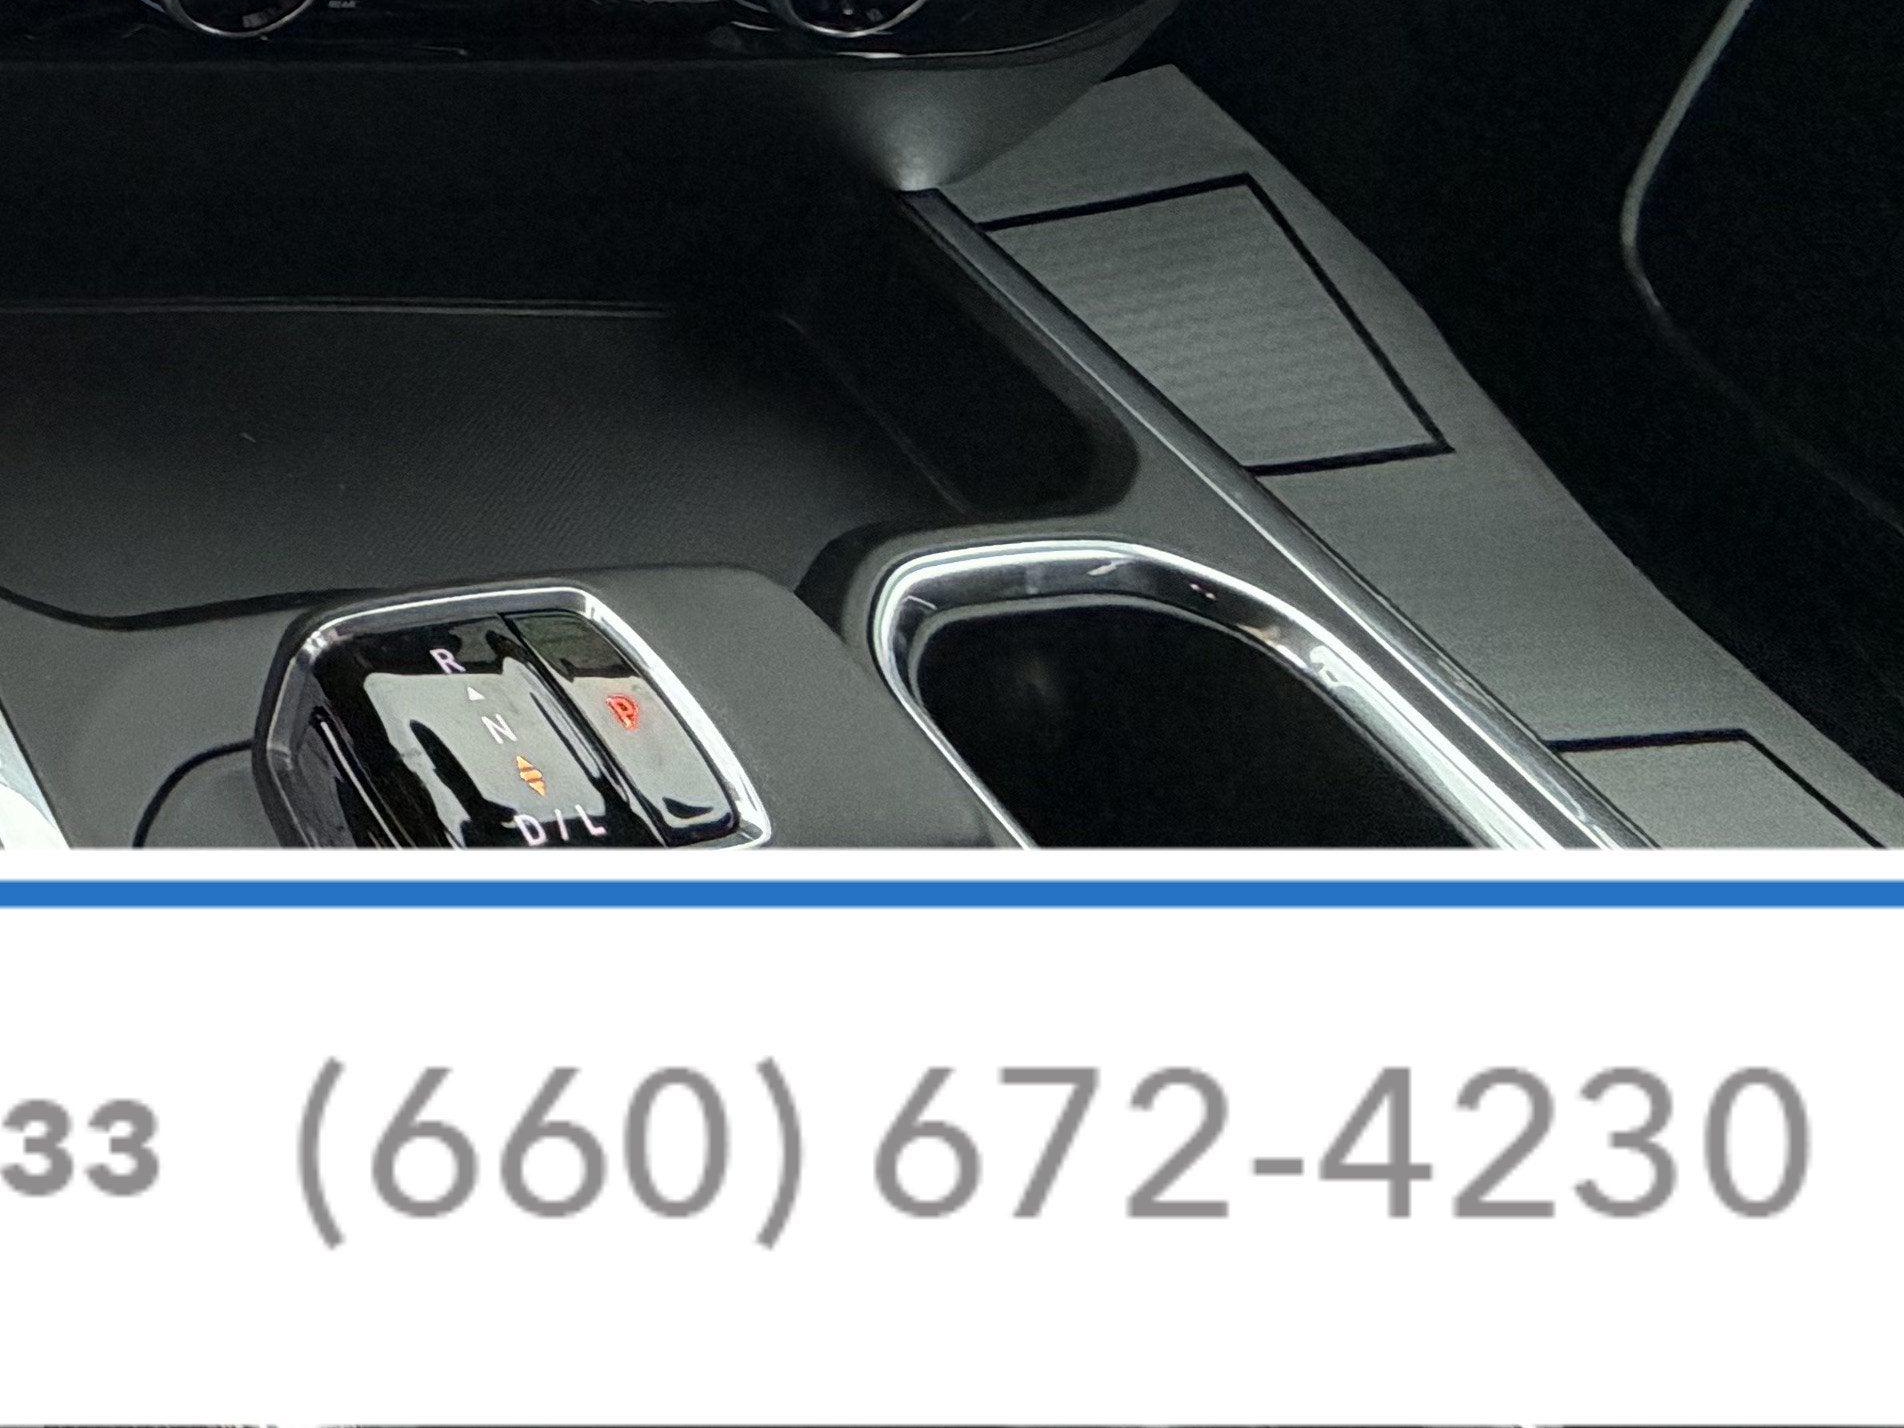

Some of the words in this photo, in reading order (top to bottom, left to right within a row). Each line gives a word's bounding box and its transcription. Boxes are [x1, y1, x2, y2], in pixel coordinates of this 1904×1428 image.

[429, 647, 467, 674] R
[605, 694, 640, 730] P
[481, 713, 519, 745] N
